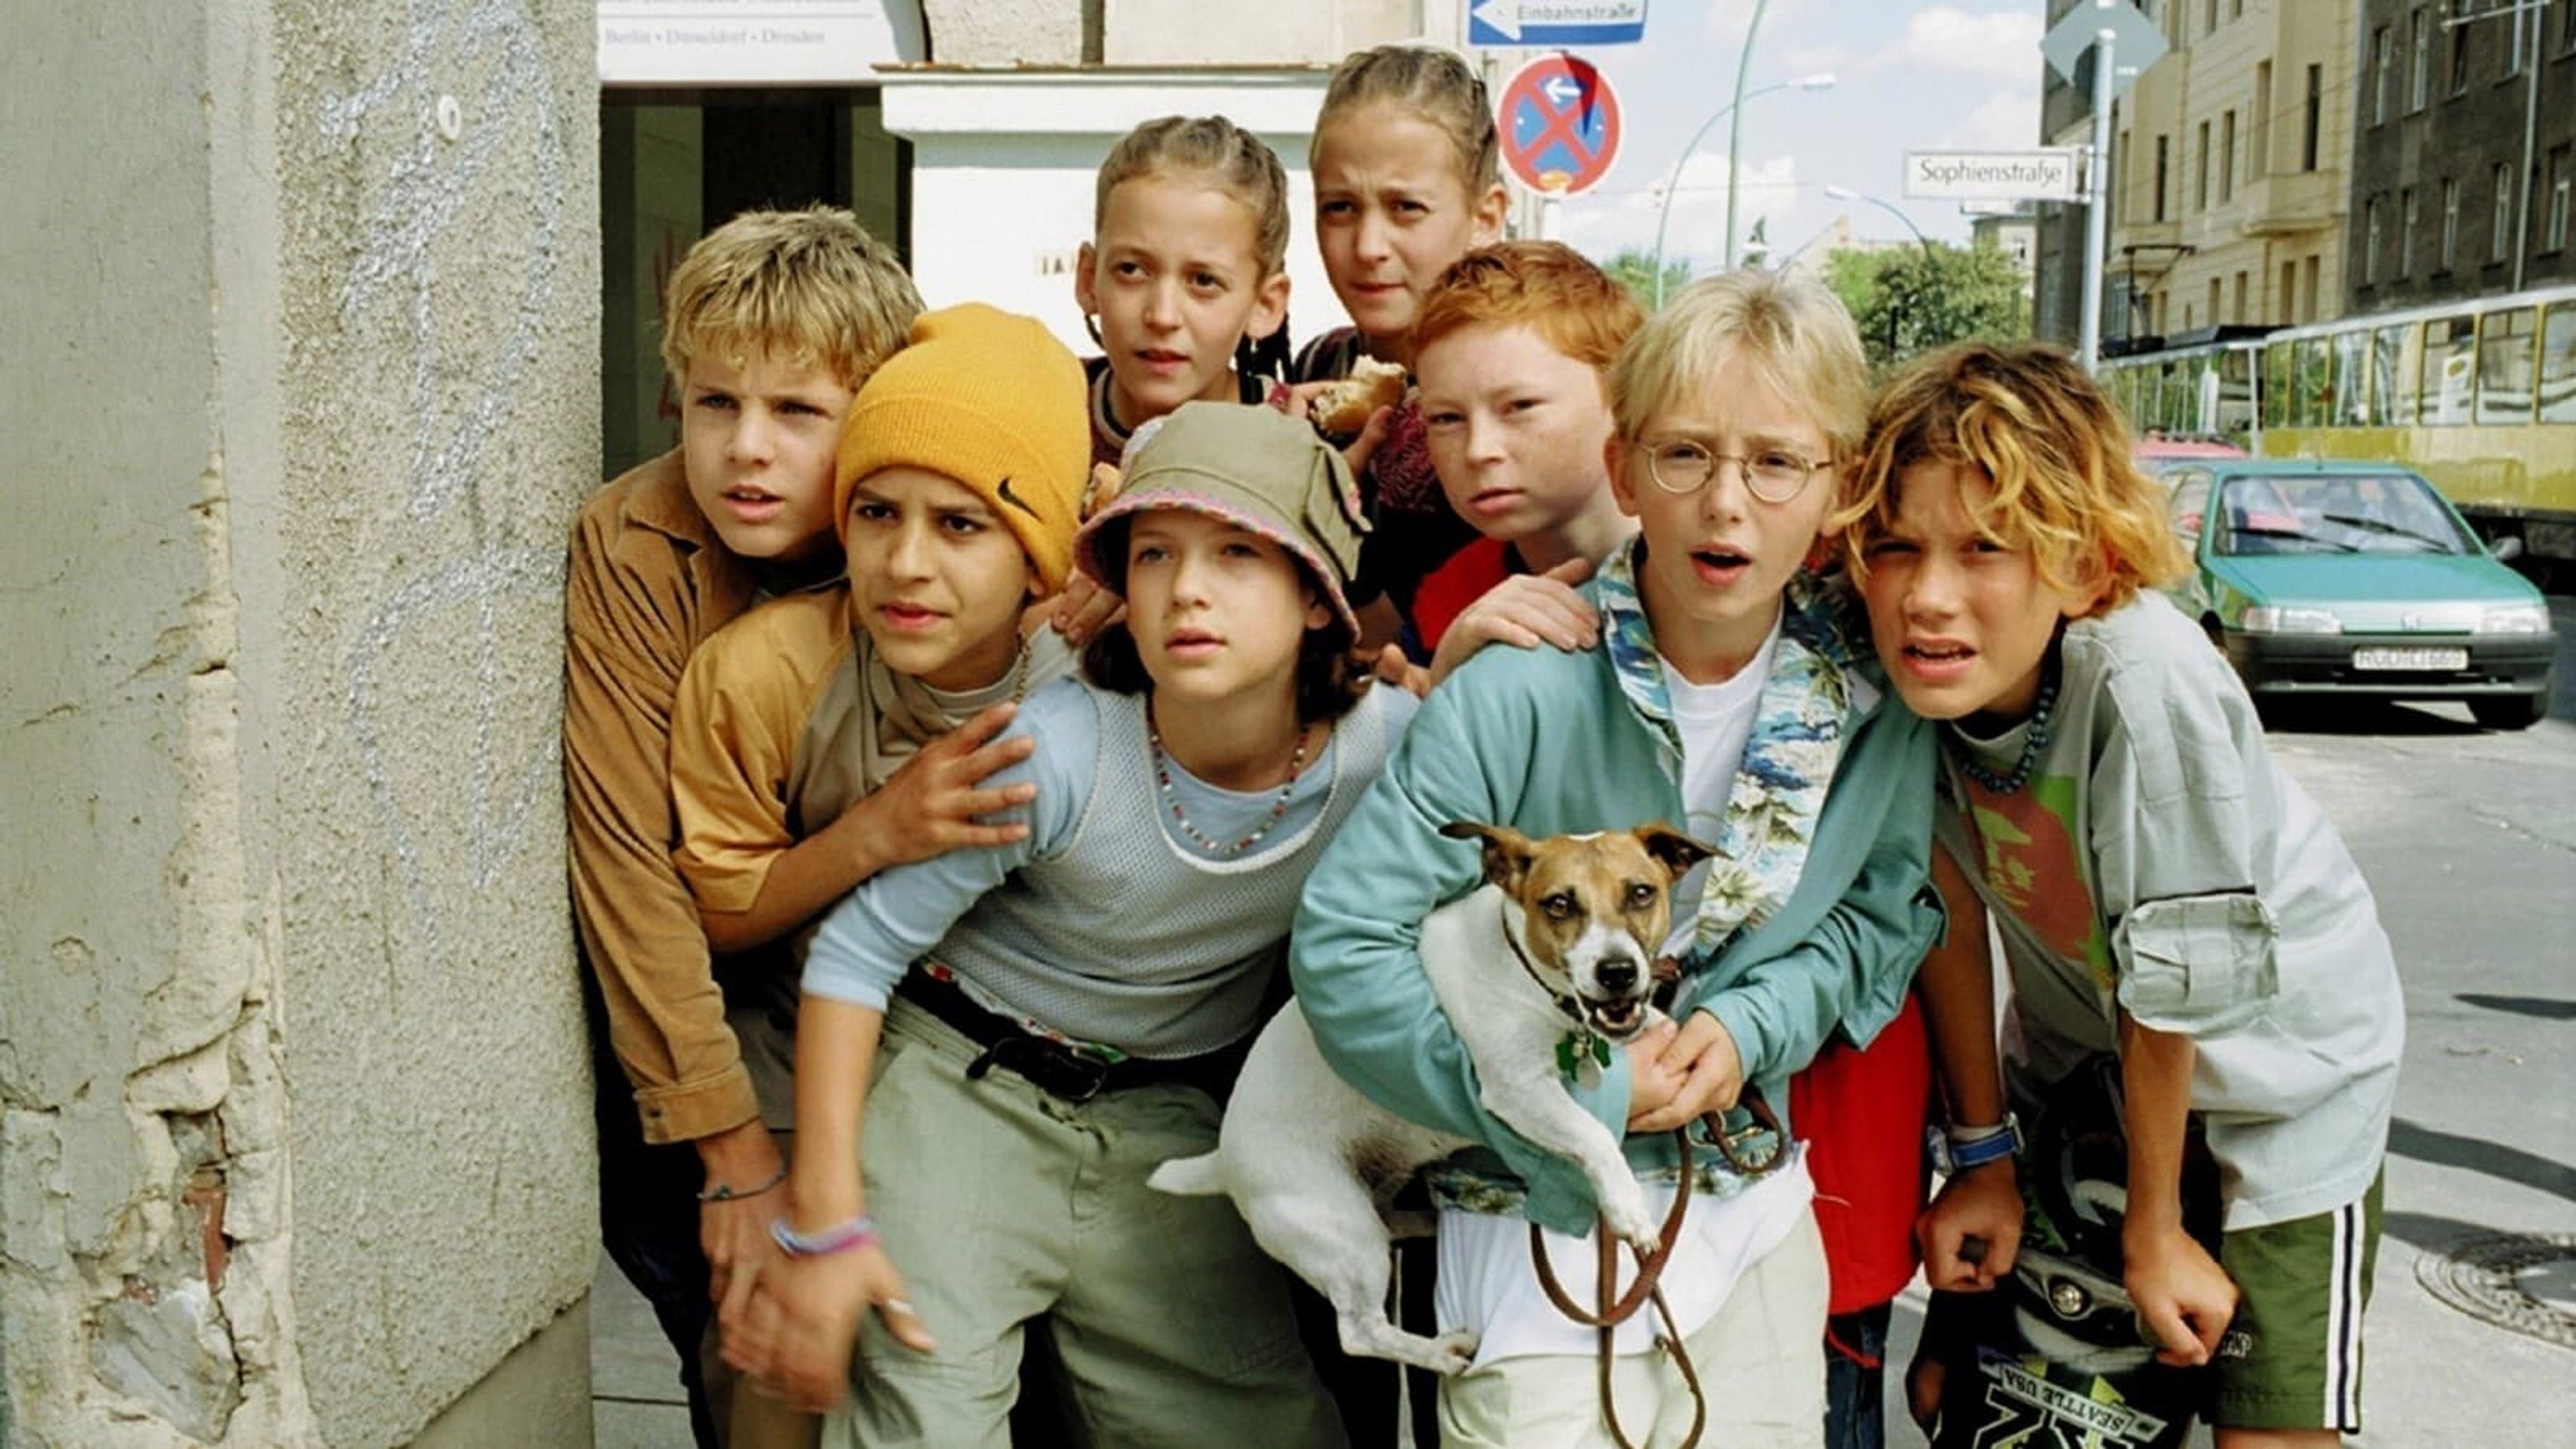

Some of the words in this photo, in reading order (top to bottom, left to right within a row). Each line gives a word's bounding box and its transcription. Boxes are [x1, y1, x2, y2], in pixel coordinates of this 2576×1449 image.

[1517, 3, 1636, 20] Einbahnstraße
[605, 28, 650, 44] Berlin
[761, 28, 825, 44] Dresden
[1919, 158, 2063, 188] Sophienstraße
[2004, 1368, 2037, 1397] USA
[2042, 1386, 2125, 1431] SEATTLE
